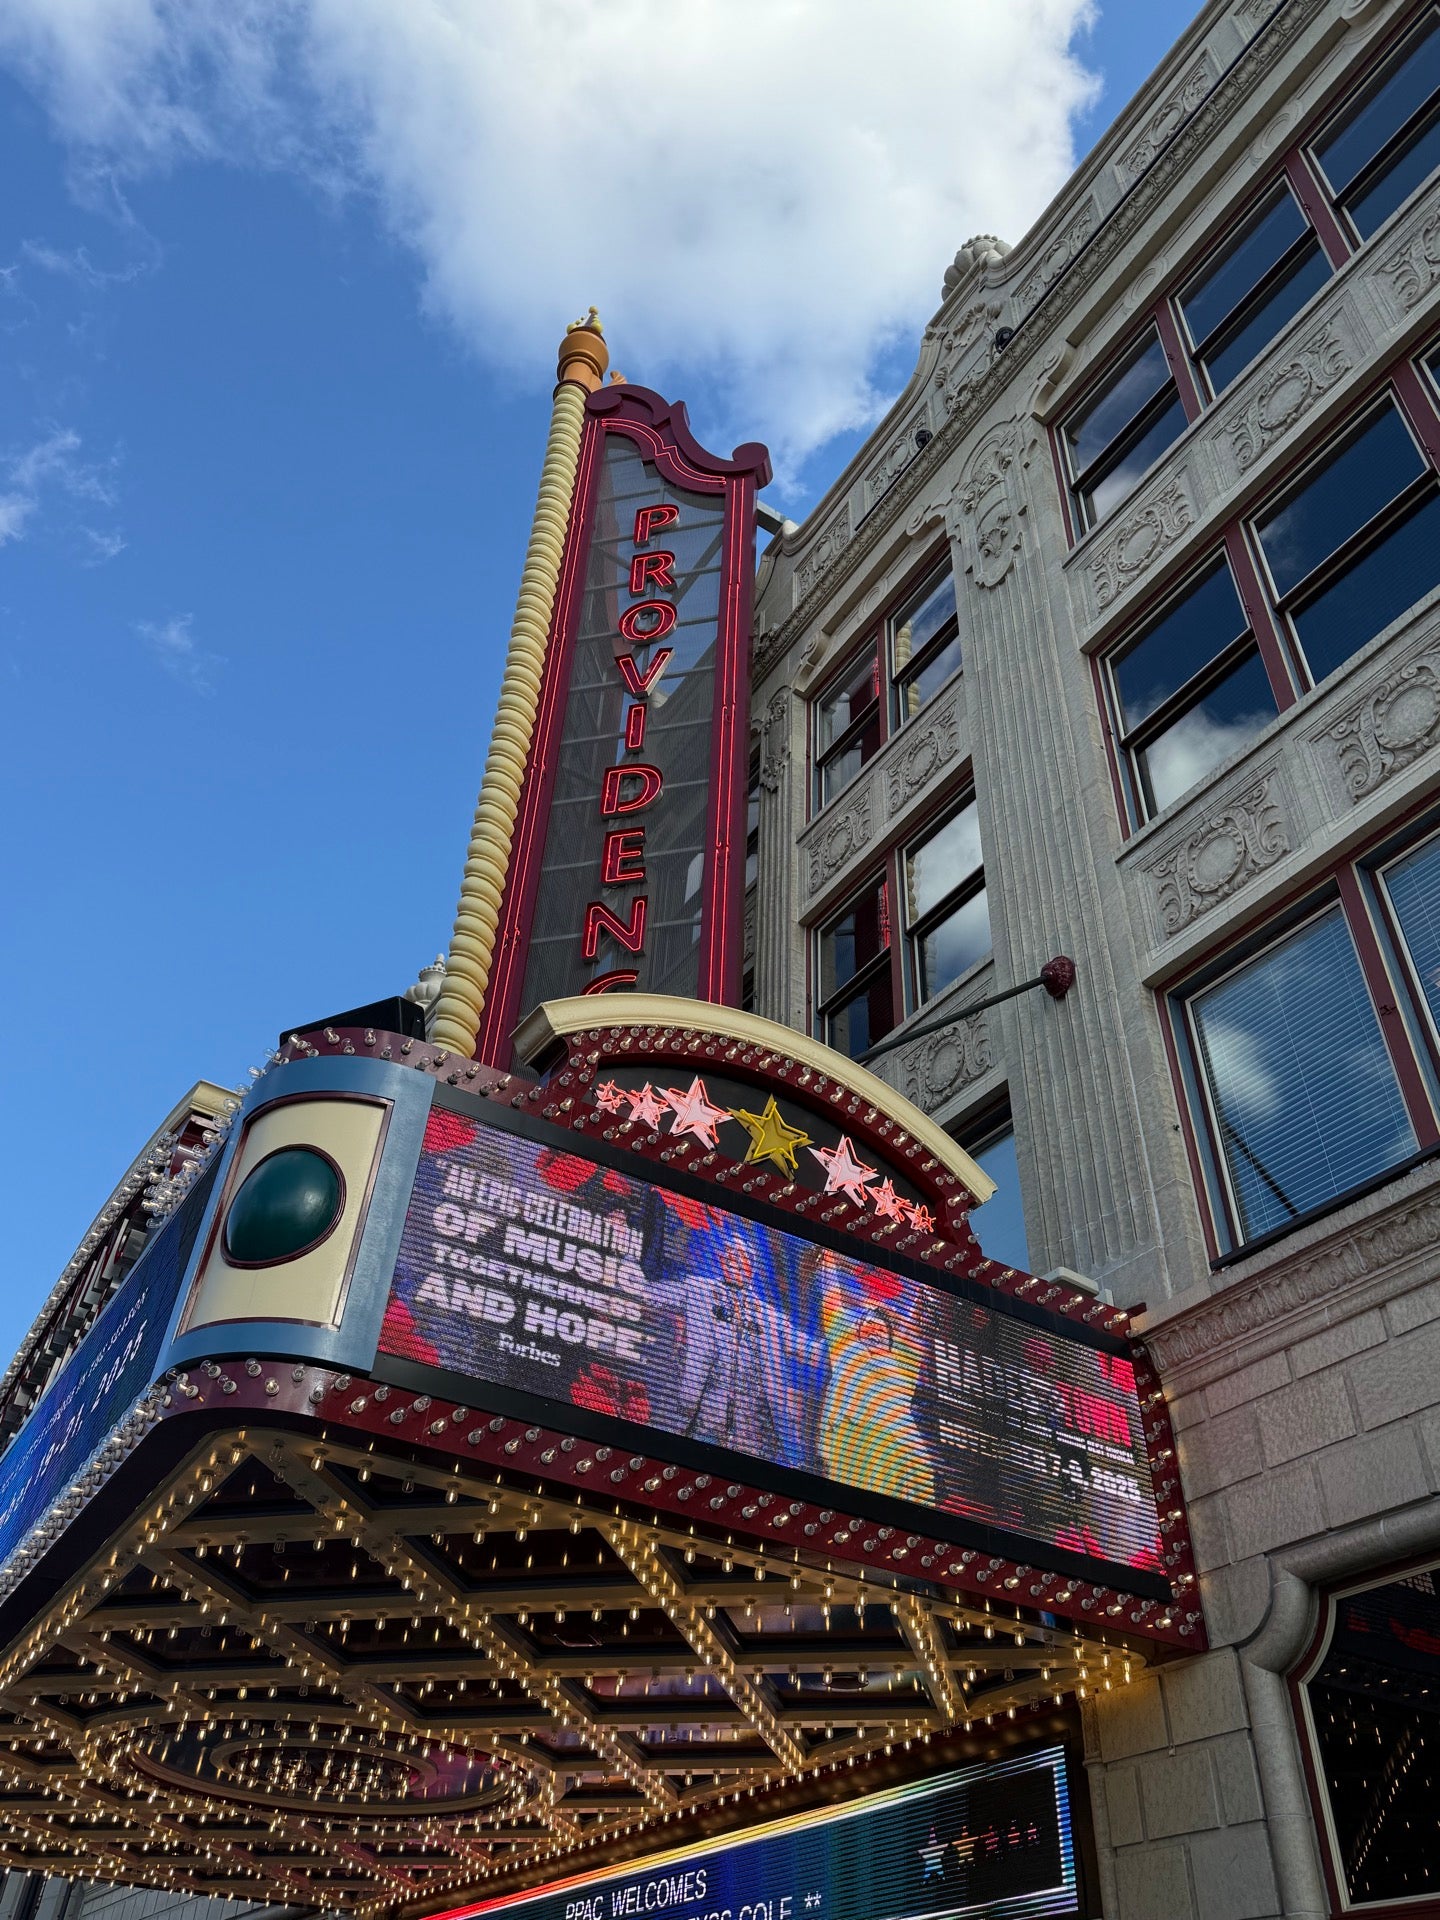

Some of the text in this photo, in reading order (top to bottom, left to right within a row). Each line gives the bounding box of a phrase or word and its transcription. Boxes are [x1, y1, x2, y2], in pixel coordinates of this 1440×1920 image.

[432, 1202, 497, 1244] OF
[523, 1190, 643, 1261] CELEBRATION
[414, 1271, 516, 1325] AND
[431, 1241, 642, 1322] TOGETHERNESS
[90, 1318, 147, 1413] 2025
[498, 1332, 561, 1367] Forbes
[1090, 1466, 1141, 1500] 2025
[565, 1869, 706, 1920] PPAC WELCOMES
